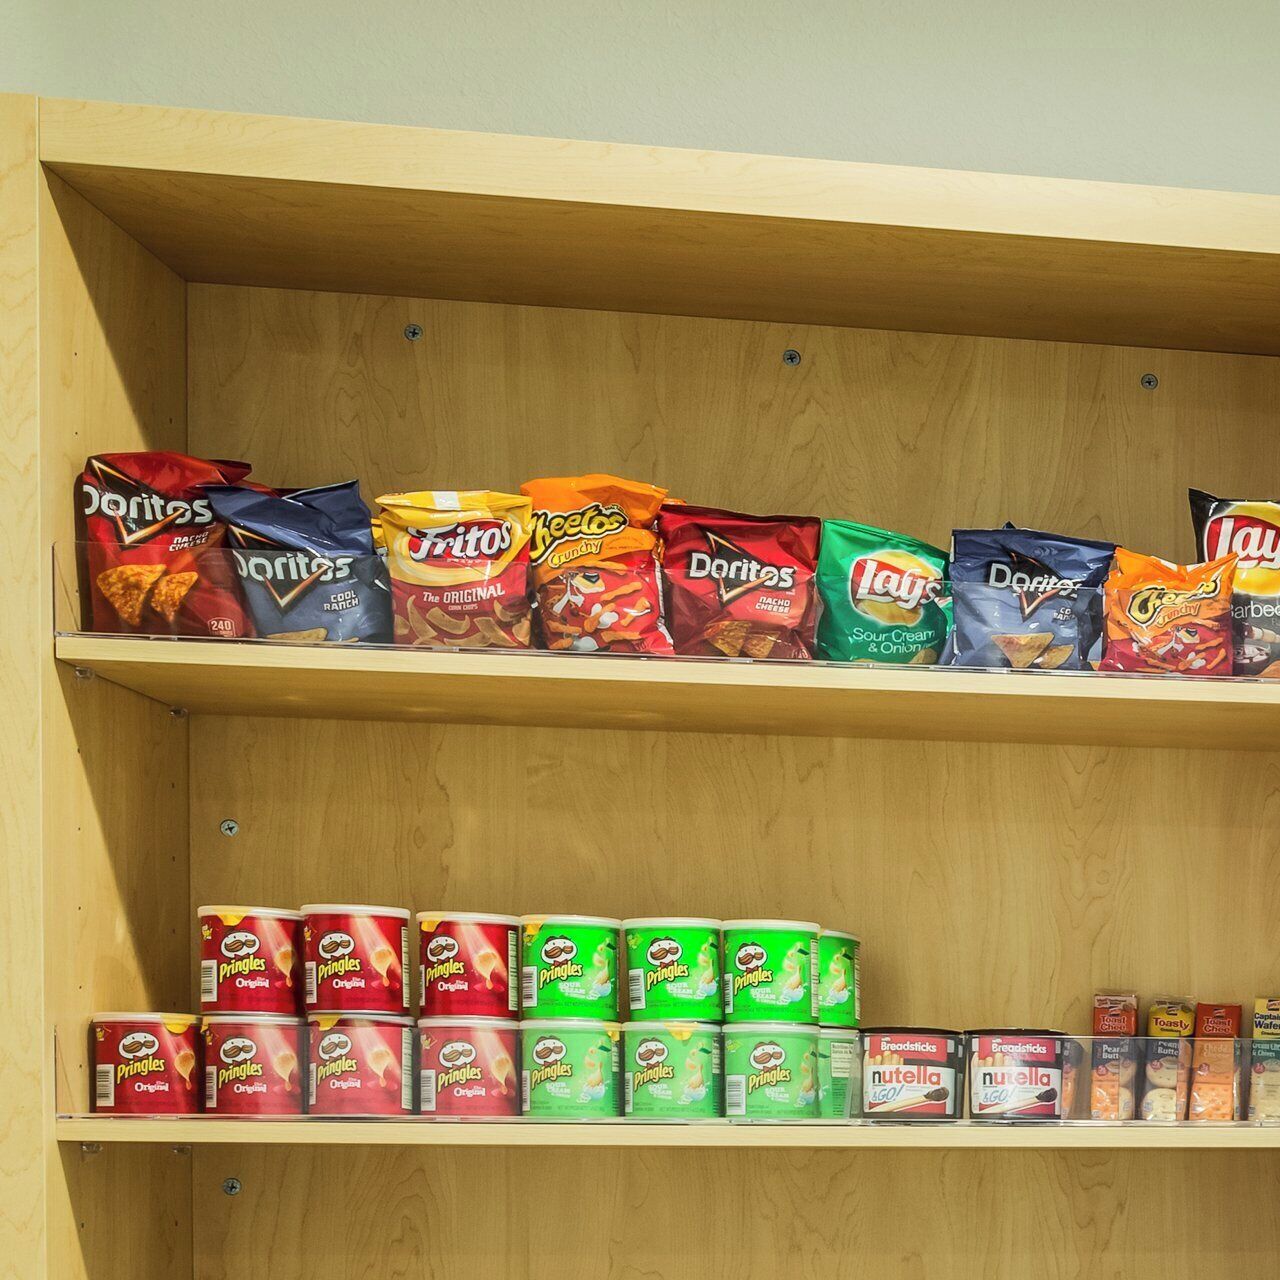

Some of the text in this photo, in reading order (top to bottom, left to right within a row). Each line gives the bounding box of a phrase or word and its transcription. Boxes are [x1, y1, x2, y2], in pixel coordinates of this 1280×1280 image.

[83, 485, 212, 524] Doritos
[408, 521, 512, 560] Fritos
[235, 550, 353, 581] Doritos
[689, 552, 795, 589] Doritos
[443, 584, 505, 603] ORIGINAL
[755, 603, 790, 613] CHEESE
[853, 628, 935, 641] Sour Cream
[868, 642, 921, 654] & Onion
[219, 955, 267, 983] Pringles
[318, 956, 361, 984] Pringles
[426, 959, 464, 985] Pringles
[539, 961, 582, 989] Pringles
[646, 962, 688, 990] Pringles
[734, 968, 773, 995] Pringles
[235, 978, 269, 989] Original
[332, 978, 365, 989] Original
[438, 981, 468, 992] Original
[1100, 1015, 1126, 1024] Toast
[1153, 1018, 1190, 1029] Toasty
[1204, 1018, 1232, 1027] Toast
[1100, 1022, 1126, 1032] Chee
[1204, 1024, 1231, 1033] Chee
[881, 1042, 936, 1053] Breadsticks
[992, 1043, 1046, 1054] Breadsticks
[117, 1057, 165, 1084] Pringles
[218, 1062, 262, 1084] Pringles
[873, 1066, 941, 1085] nutella
[983, 1067, 1050, 1086] nutella
[134, 1082, 169, 1092] Original
[234, 1083, 267, 1094] Original
[329, 1079, 361, 1089] Original
